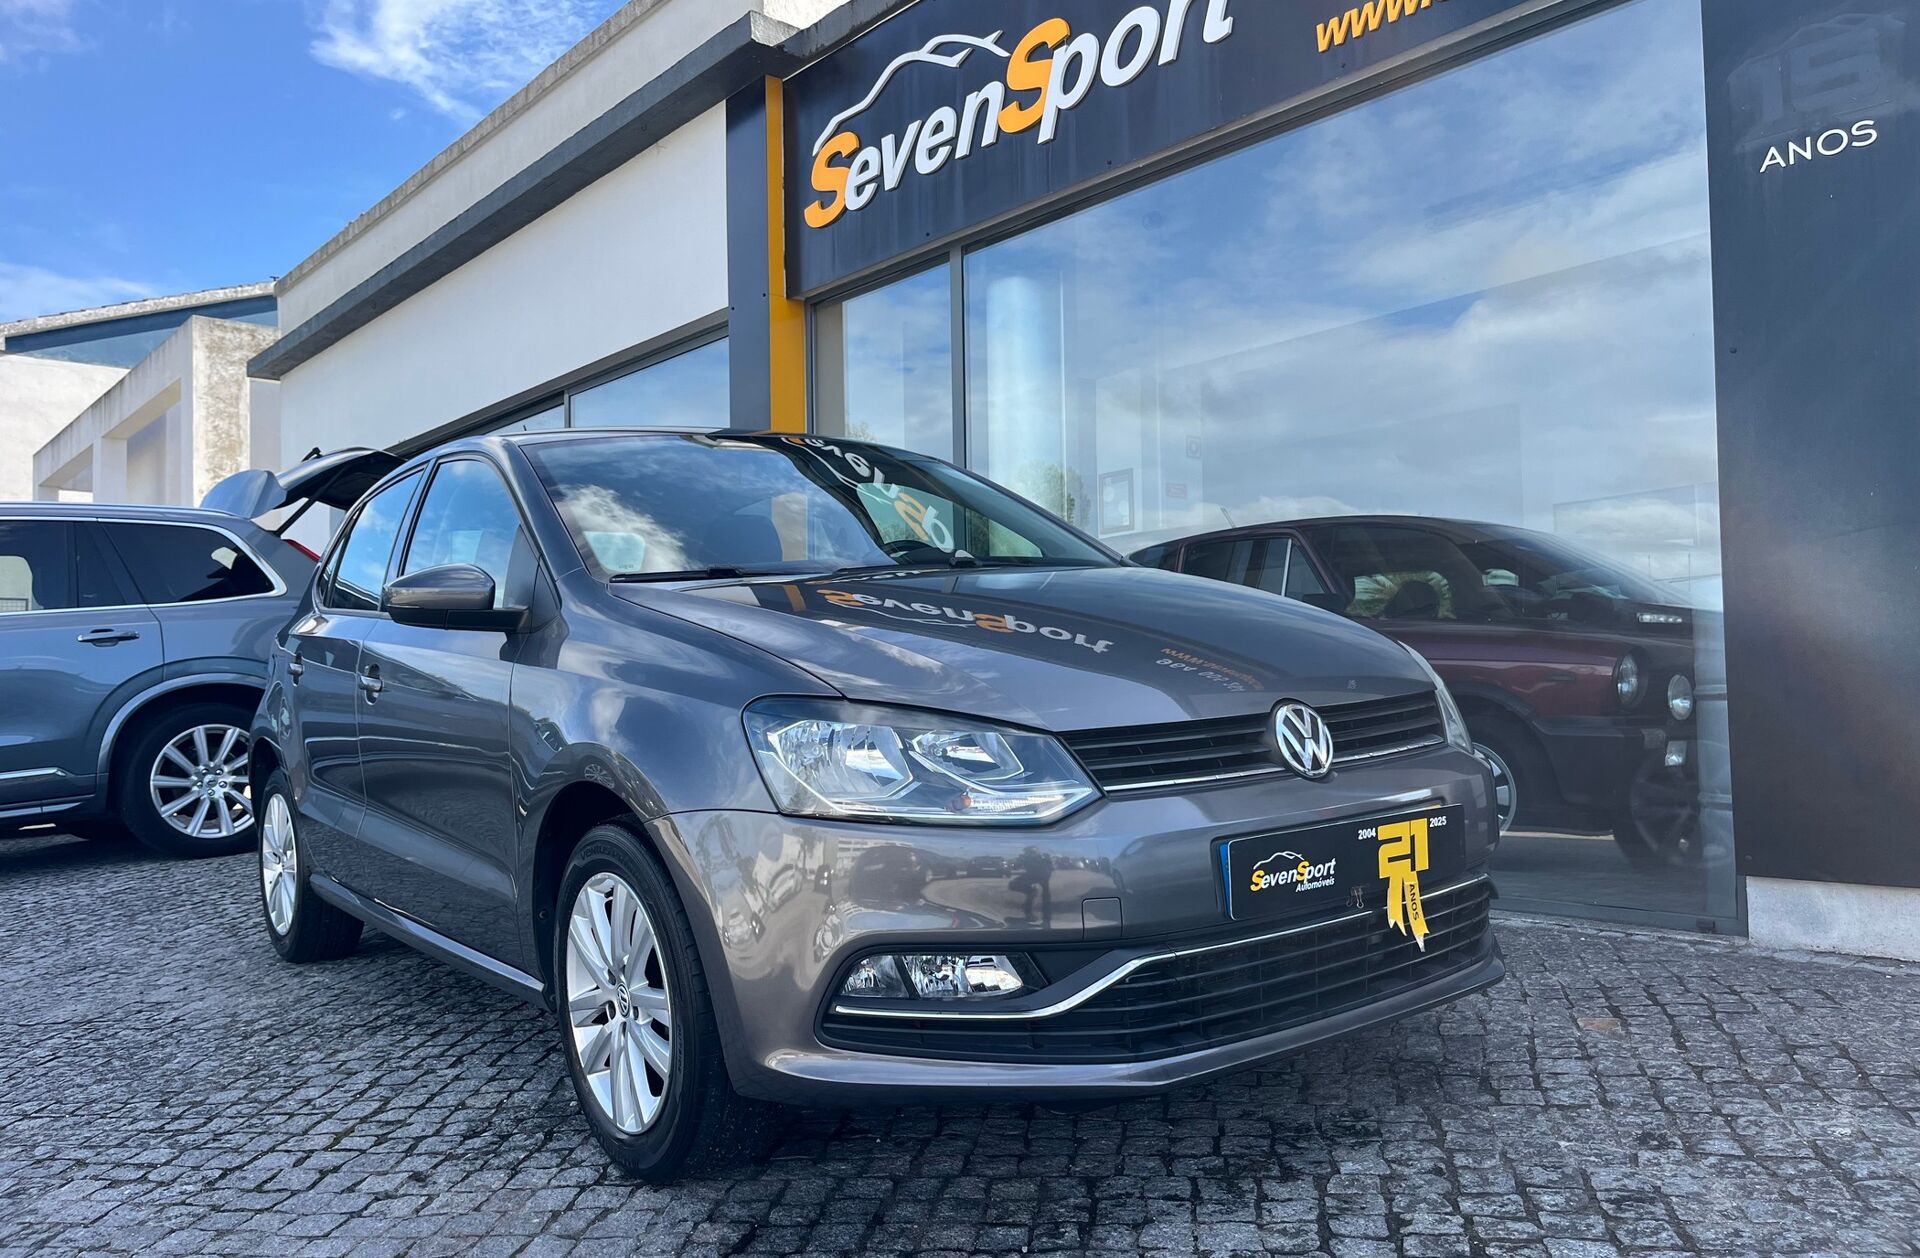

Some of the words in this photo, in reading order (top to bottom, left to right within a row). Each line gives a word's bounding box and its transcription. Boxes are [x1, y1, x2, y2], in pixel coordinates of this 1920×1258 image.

[1760, 120, 1878, 173] ANOS
[1358, 827, 1376, 840] 2004
[1429, 816, 1447, 828] 2025
[1378, 818, 1429, 879] 21
[1250, 857, 1336, 892] SevenSport
[1295, 876, 1335, 892] Automóveis
[1409, 883, 1420, 921] ANOS
